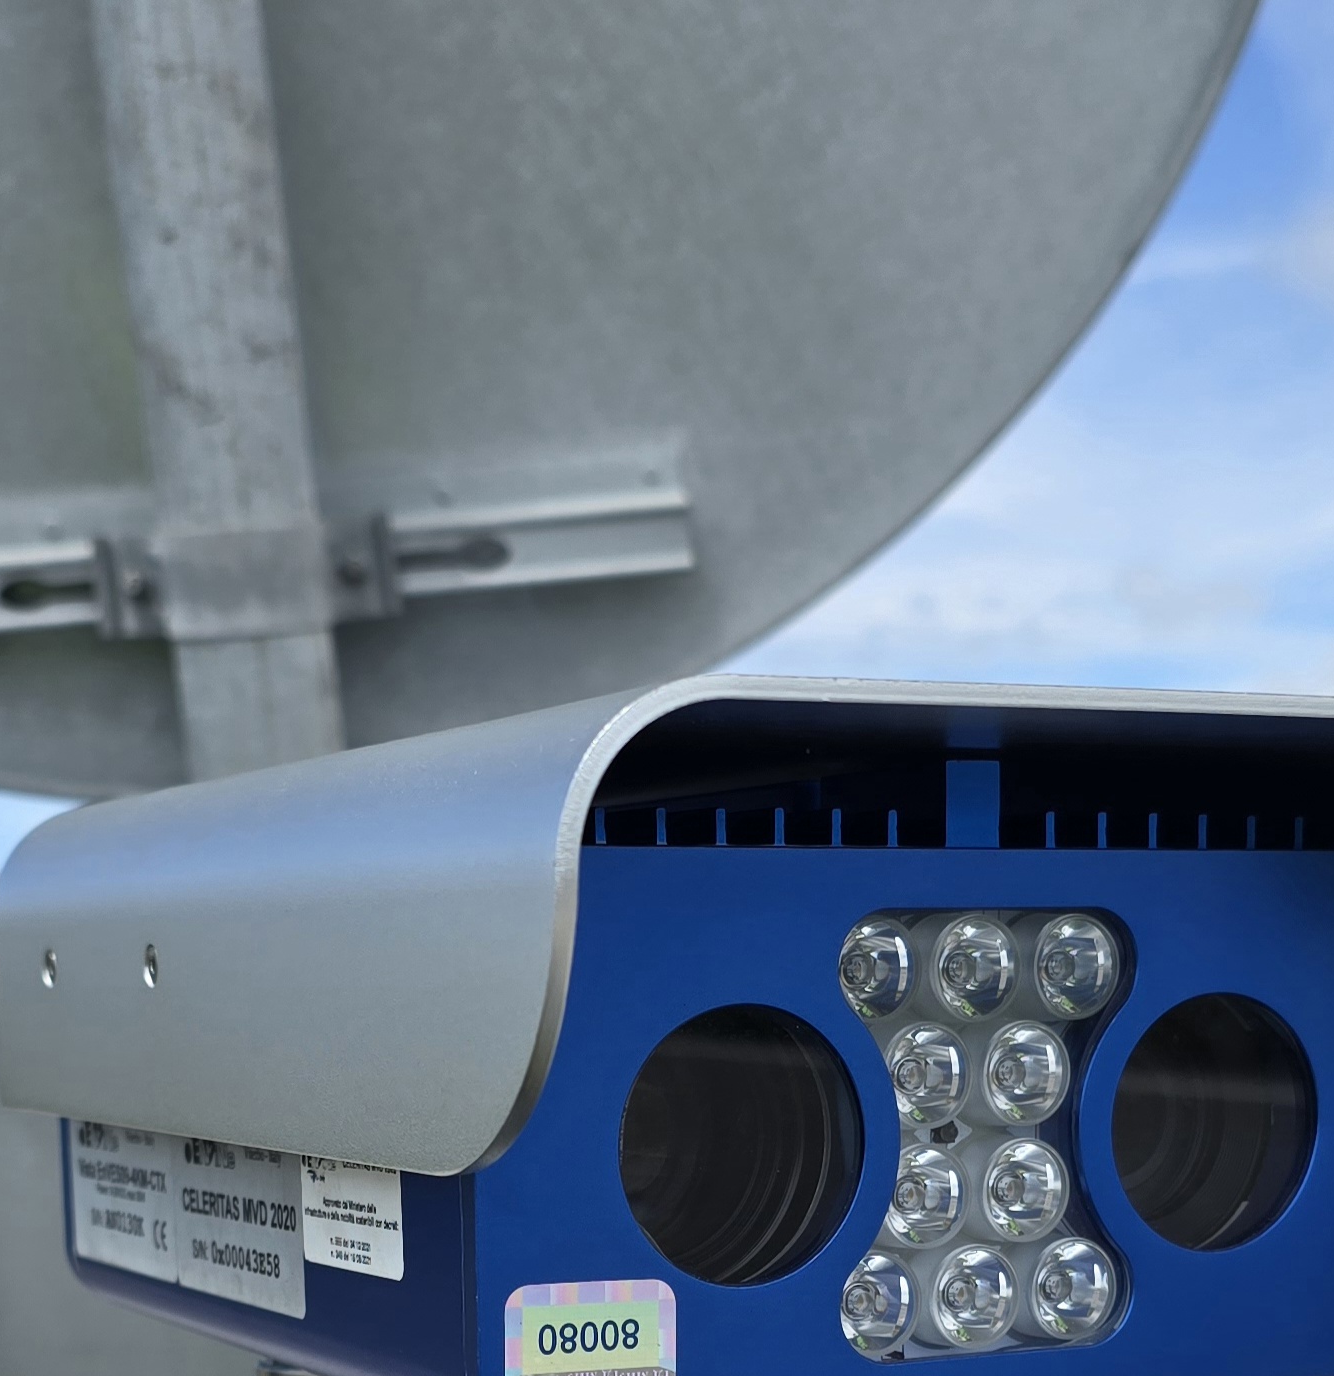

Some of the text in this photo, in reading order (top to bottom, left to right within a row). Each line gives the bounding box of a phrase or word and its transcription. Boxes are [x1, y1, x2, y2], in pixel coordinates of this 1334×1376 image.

[182, 1187, 297, 1232] CELERITAS MVD 2020
